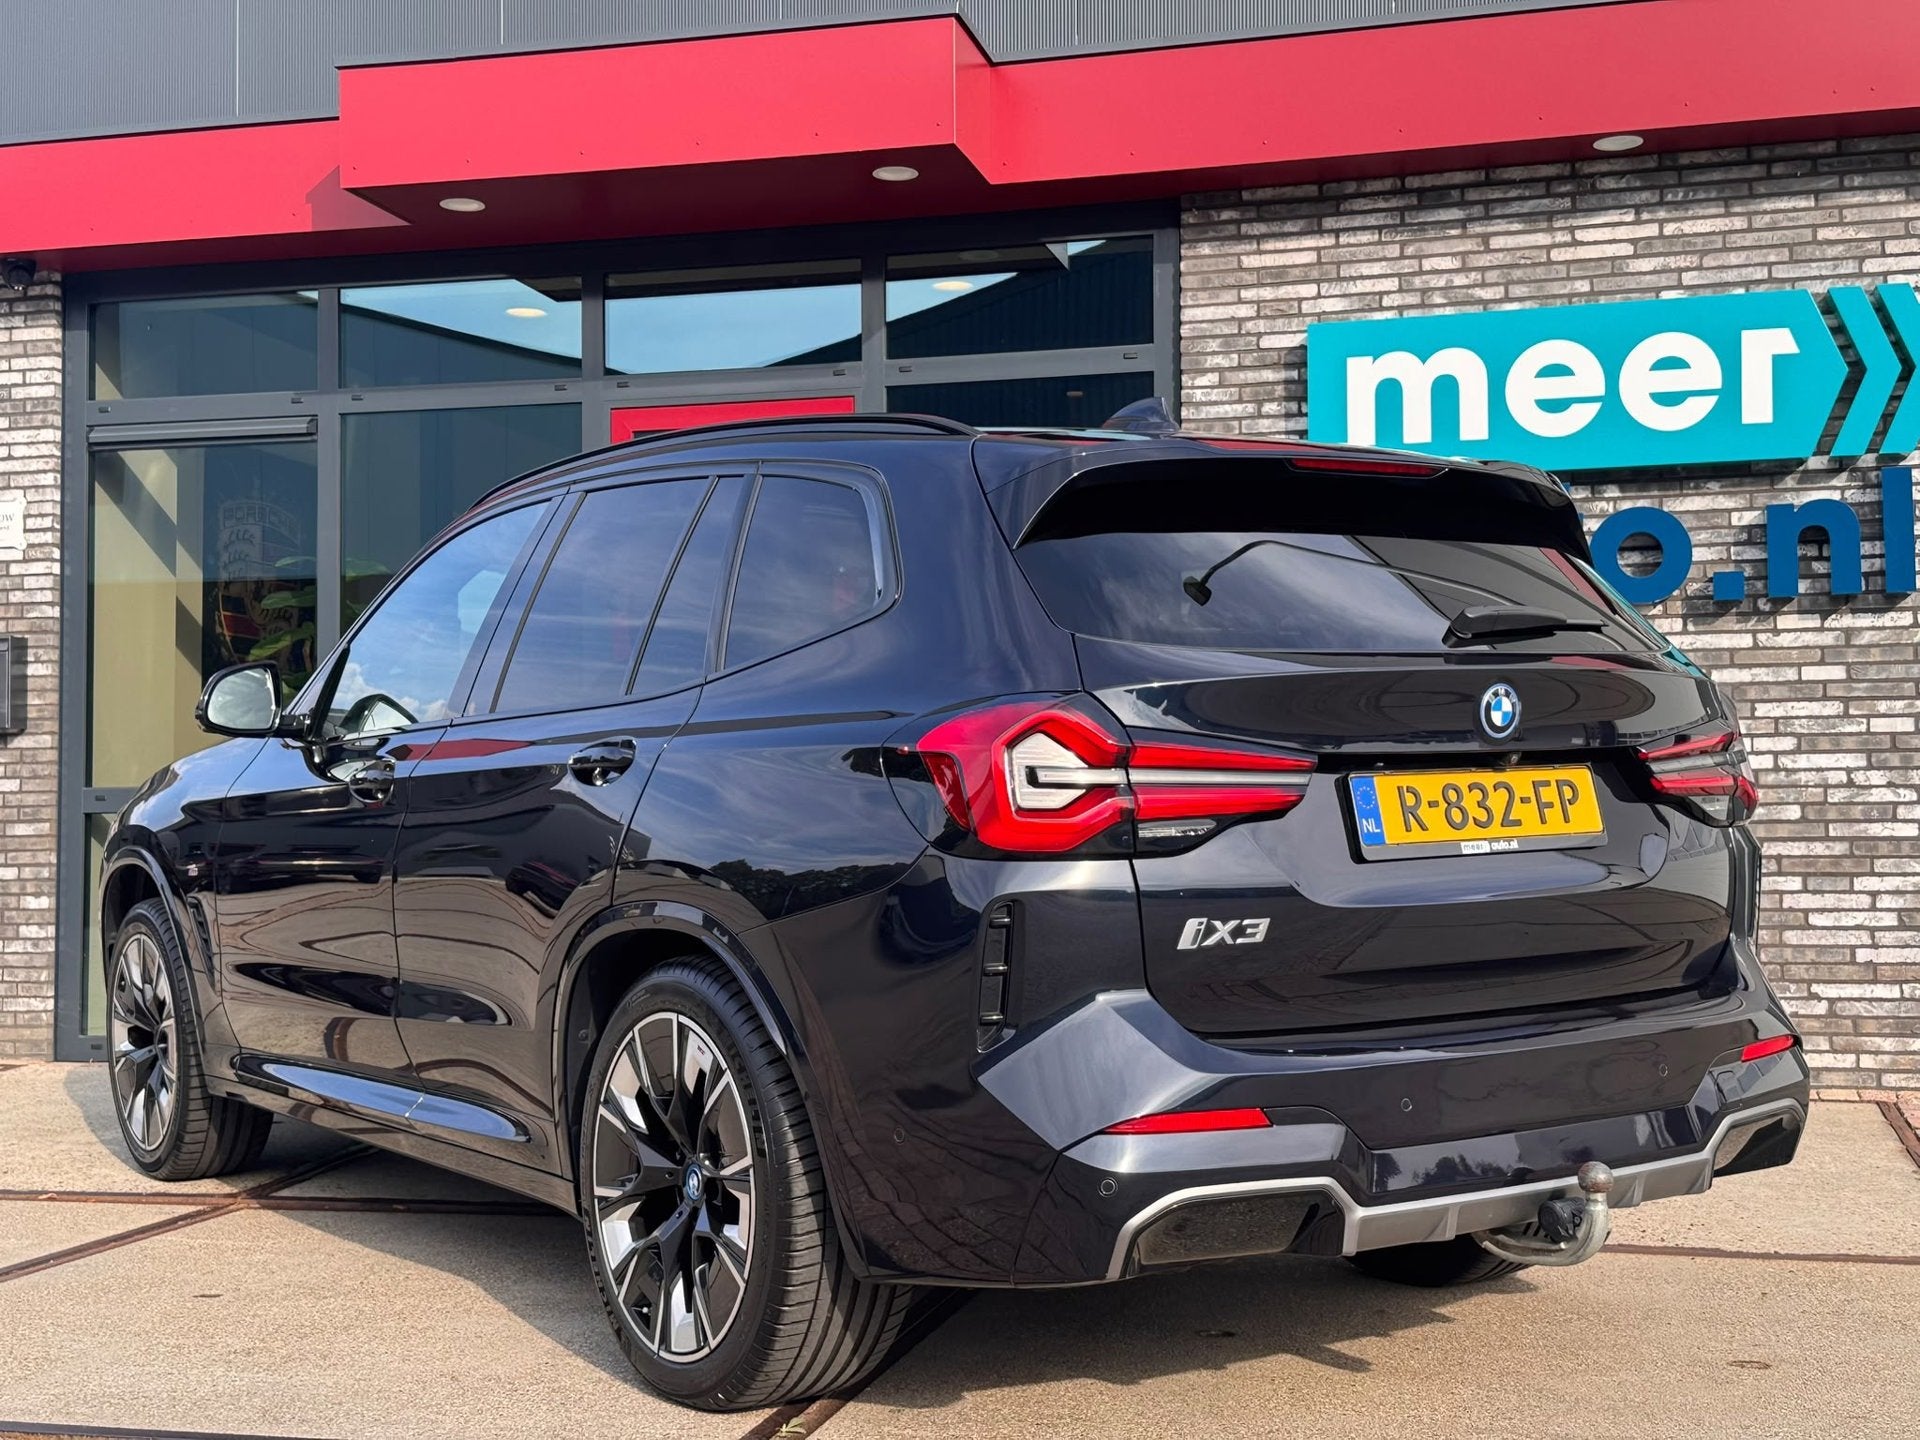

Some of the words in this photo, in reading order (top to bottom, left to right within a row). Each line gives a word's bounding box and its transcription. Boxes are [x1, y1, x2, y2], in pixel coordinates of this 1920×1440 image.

[1346, 328, 1800, 446] meer
[1580, 467, 1917, 606] o.nl
[1362, 817, 1381, 833] NL
[1397, 779, 1580, 832] R-832-FP
